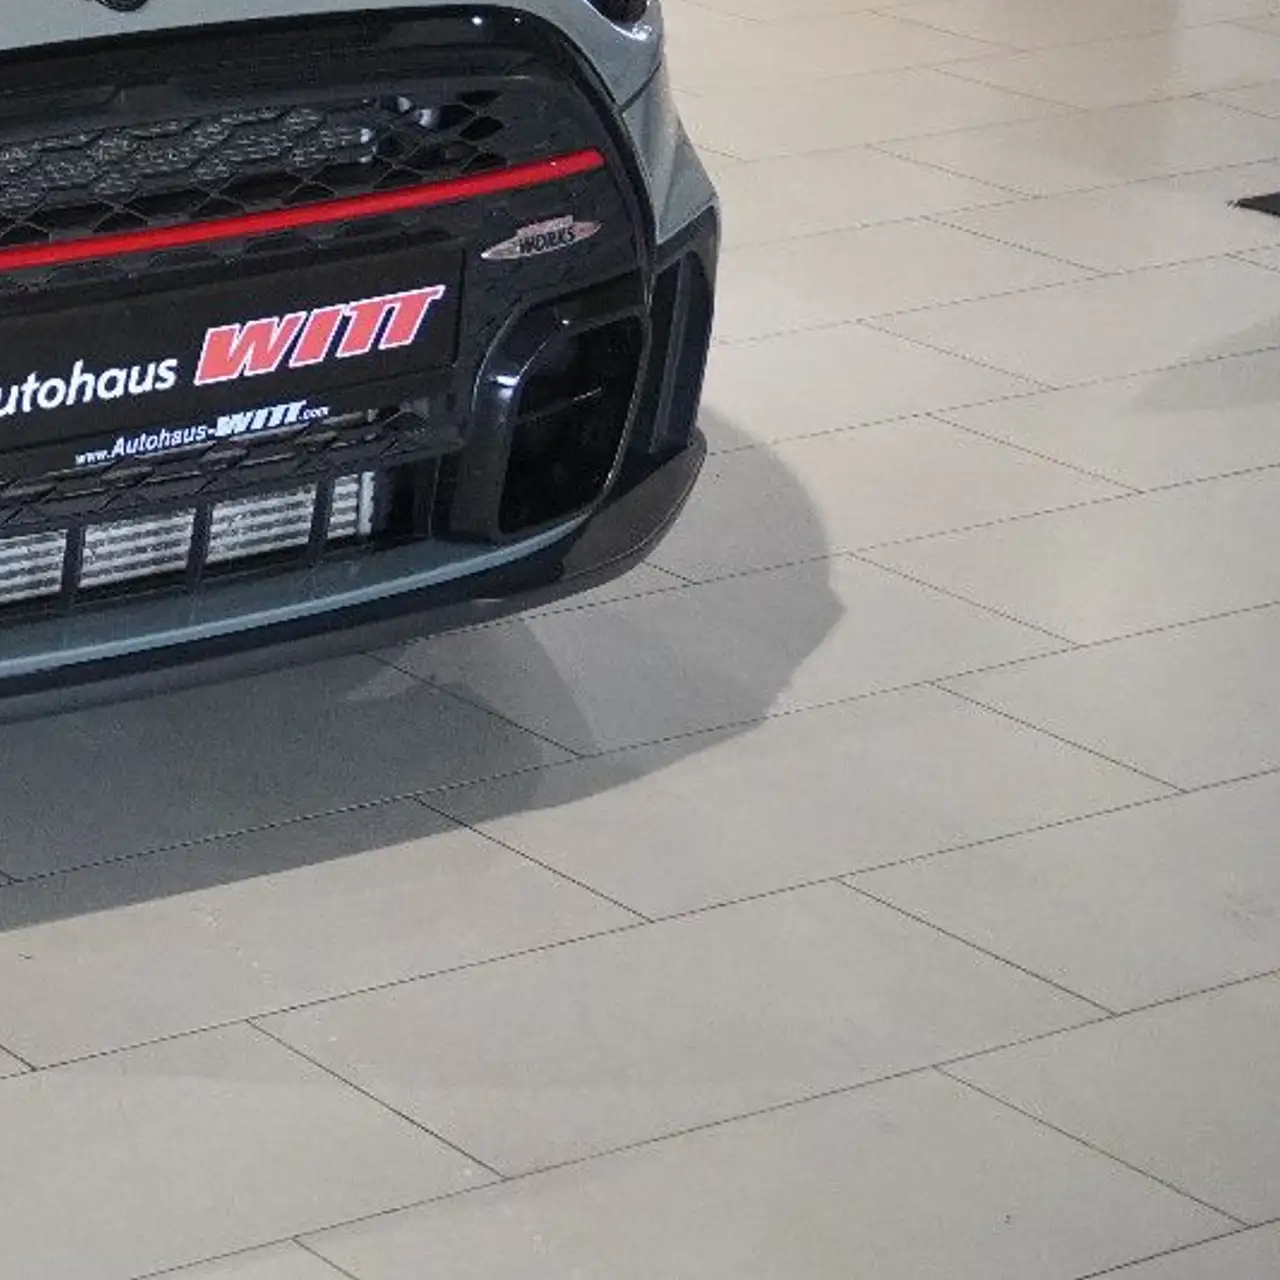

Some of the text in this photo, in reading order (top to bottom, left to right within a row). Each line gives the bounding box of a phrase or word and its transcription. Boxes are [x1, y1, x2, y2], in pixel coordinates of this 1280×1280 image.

[518, 226, 576, 254] WORKS
[194, 284, 446, 387] WITT
[74, 400, 330, 465] www.Autohaus-WITT.com
